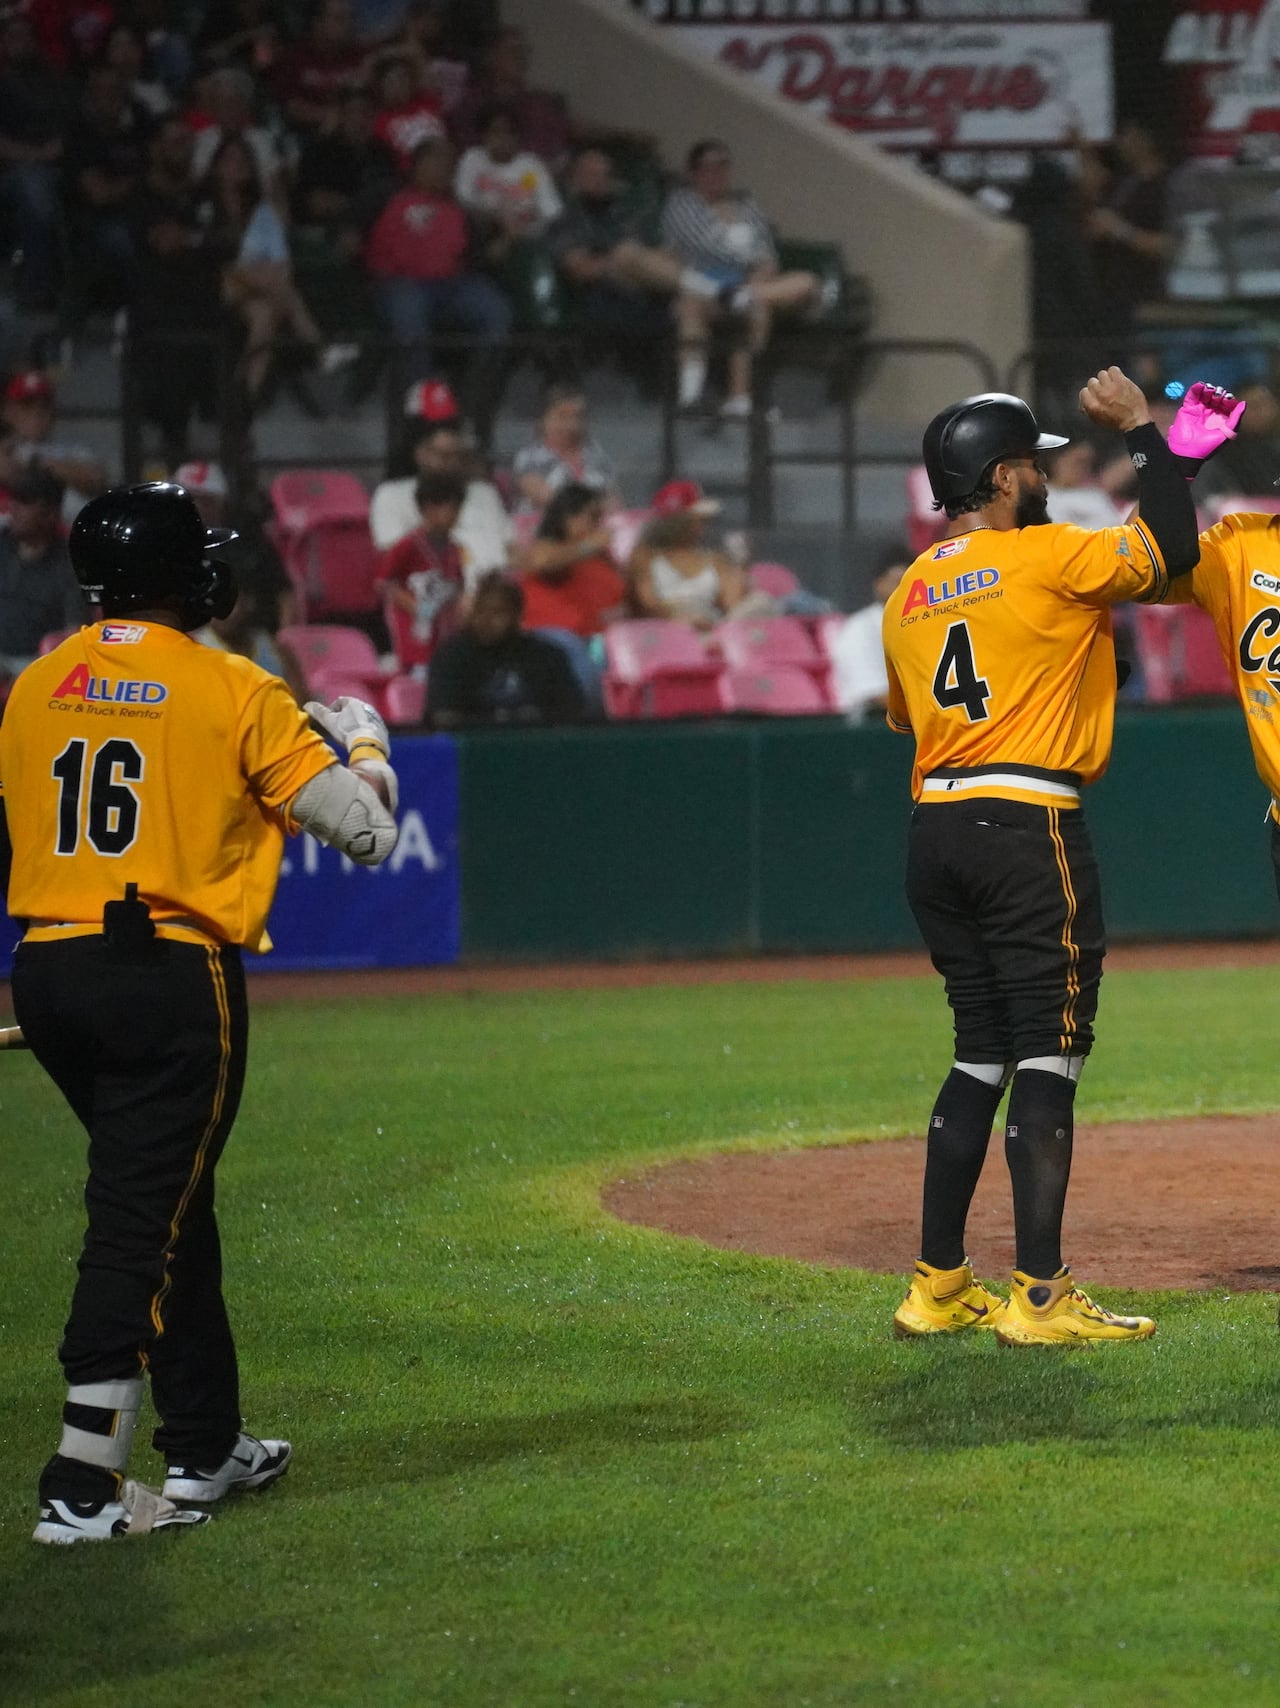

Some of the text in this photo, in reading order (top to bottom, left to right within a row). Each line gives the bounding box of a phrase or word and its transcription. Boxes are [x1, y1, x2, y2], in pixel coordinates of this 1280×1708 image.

[900, 588, 1004, 628] Car & Truck Rental
[902, 568, 1000, 617] ALLIED
[51, 663, 168, 704] ALLIED
[932, 618, 992, 724] 4
[48, 699, 164, 720] Car & Truck Rental
[51, 738, 144, 857] 16
